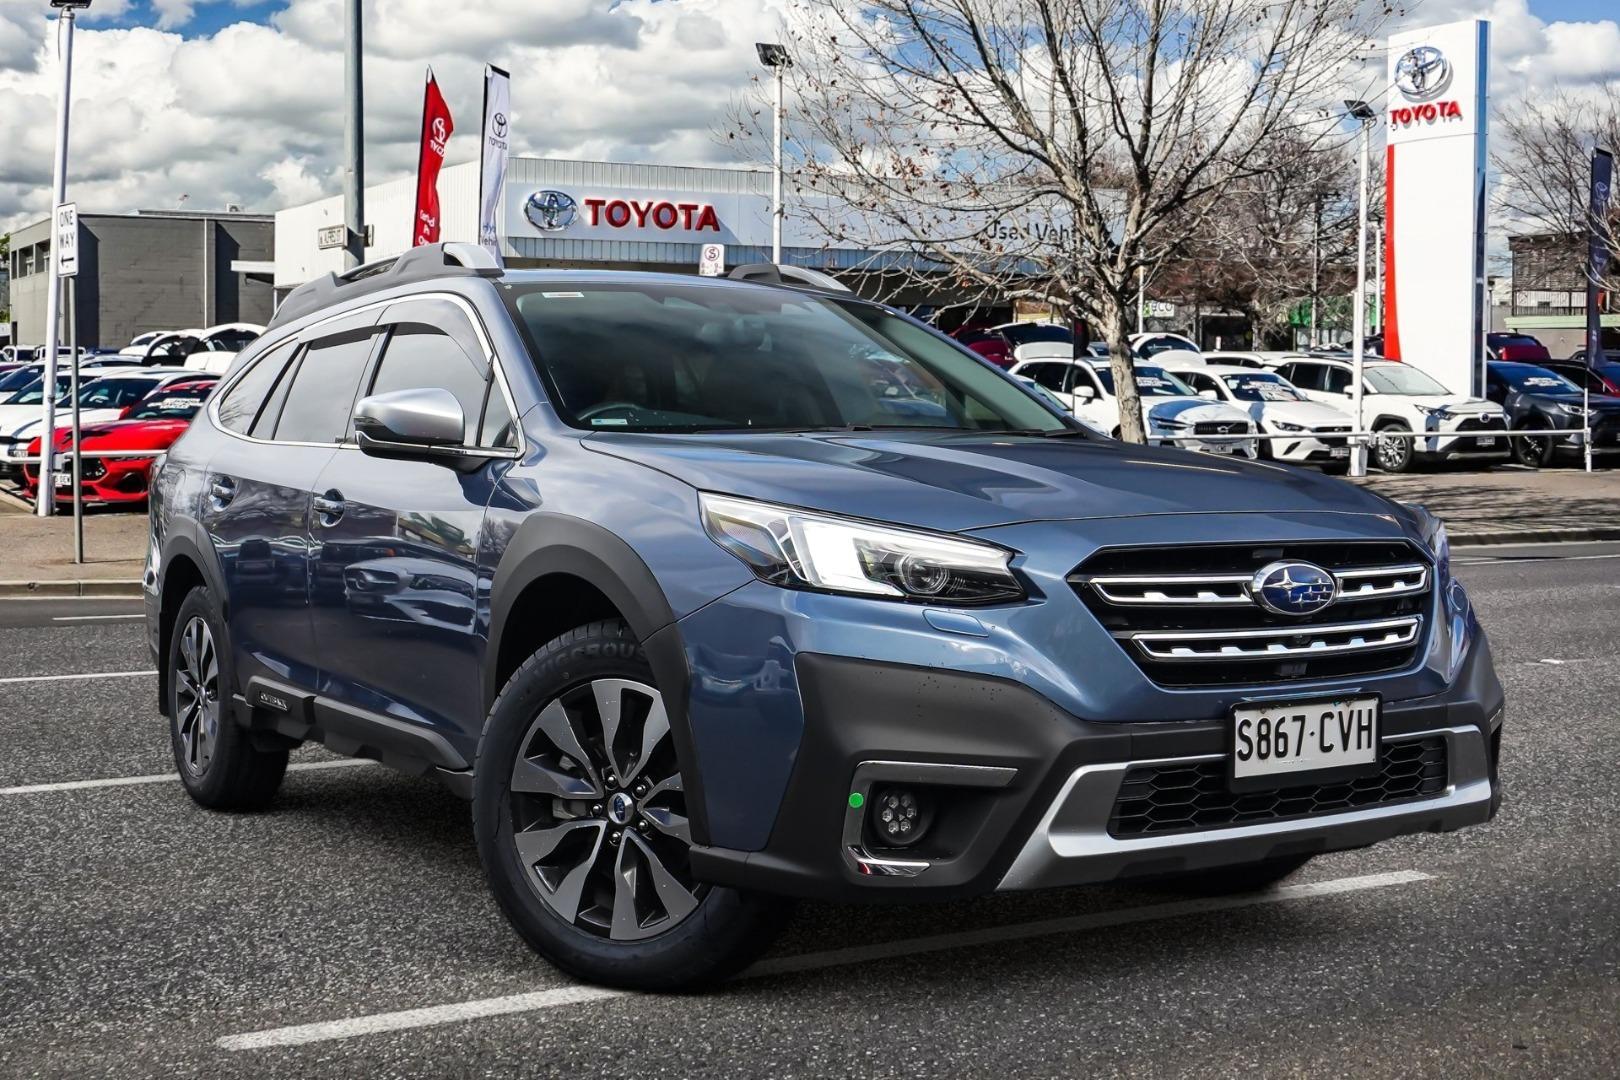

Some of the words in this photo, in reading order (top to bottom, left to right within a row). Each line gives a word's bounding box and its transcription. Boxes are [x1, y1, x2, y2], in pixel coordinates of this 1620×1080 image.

[1389, 101, 1463, 125] TOYOTA
[59, 209, 75, 228] ONE
[584, 198, 721, 232] TOYOTA
[59, 231, 75, 249] WAY
[985, 220, 1030, 241] Used
